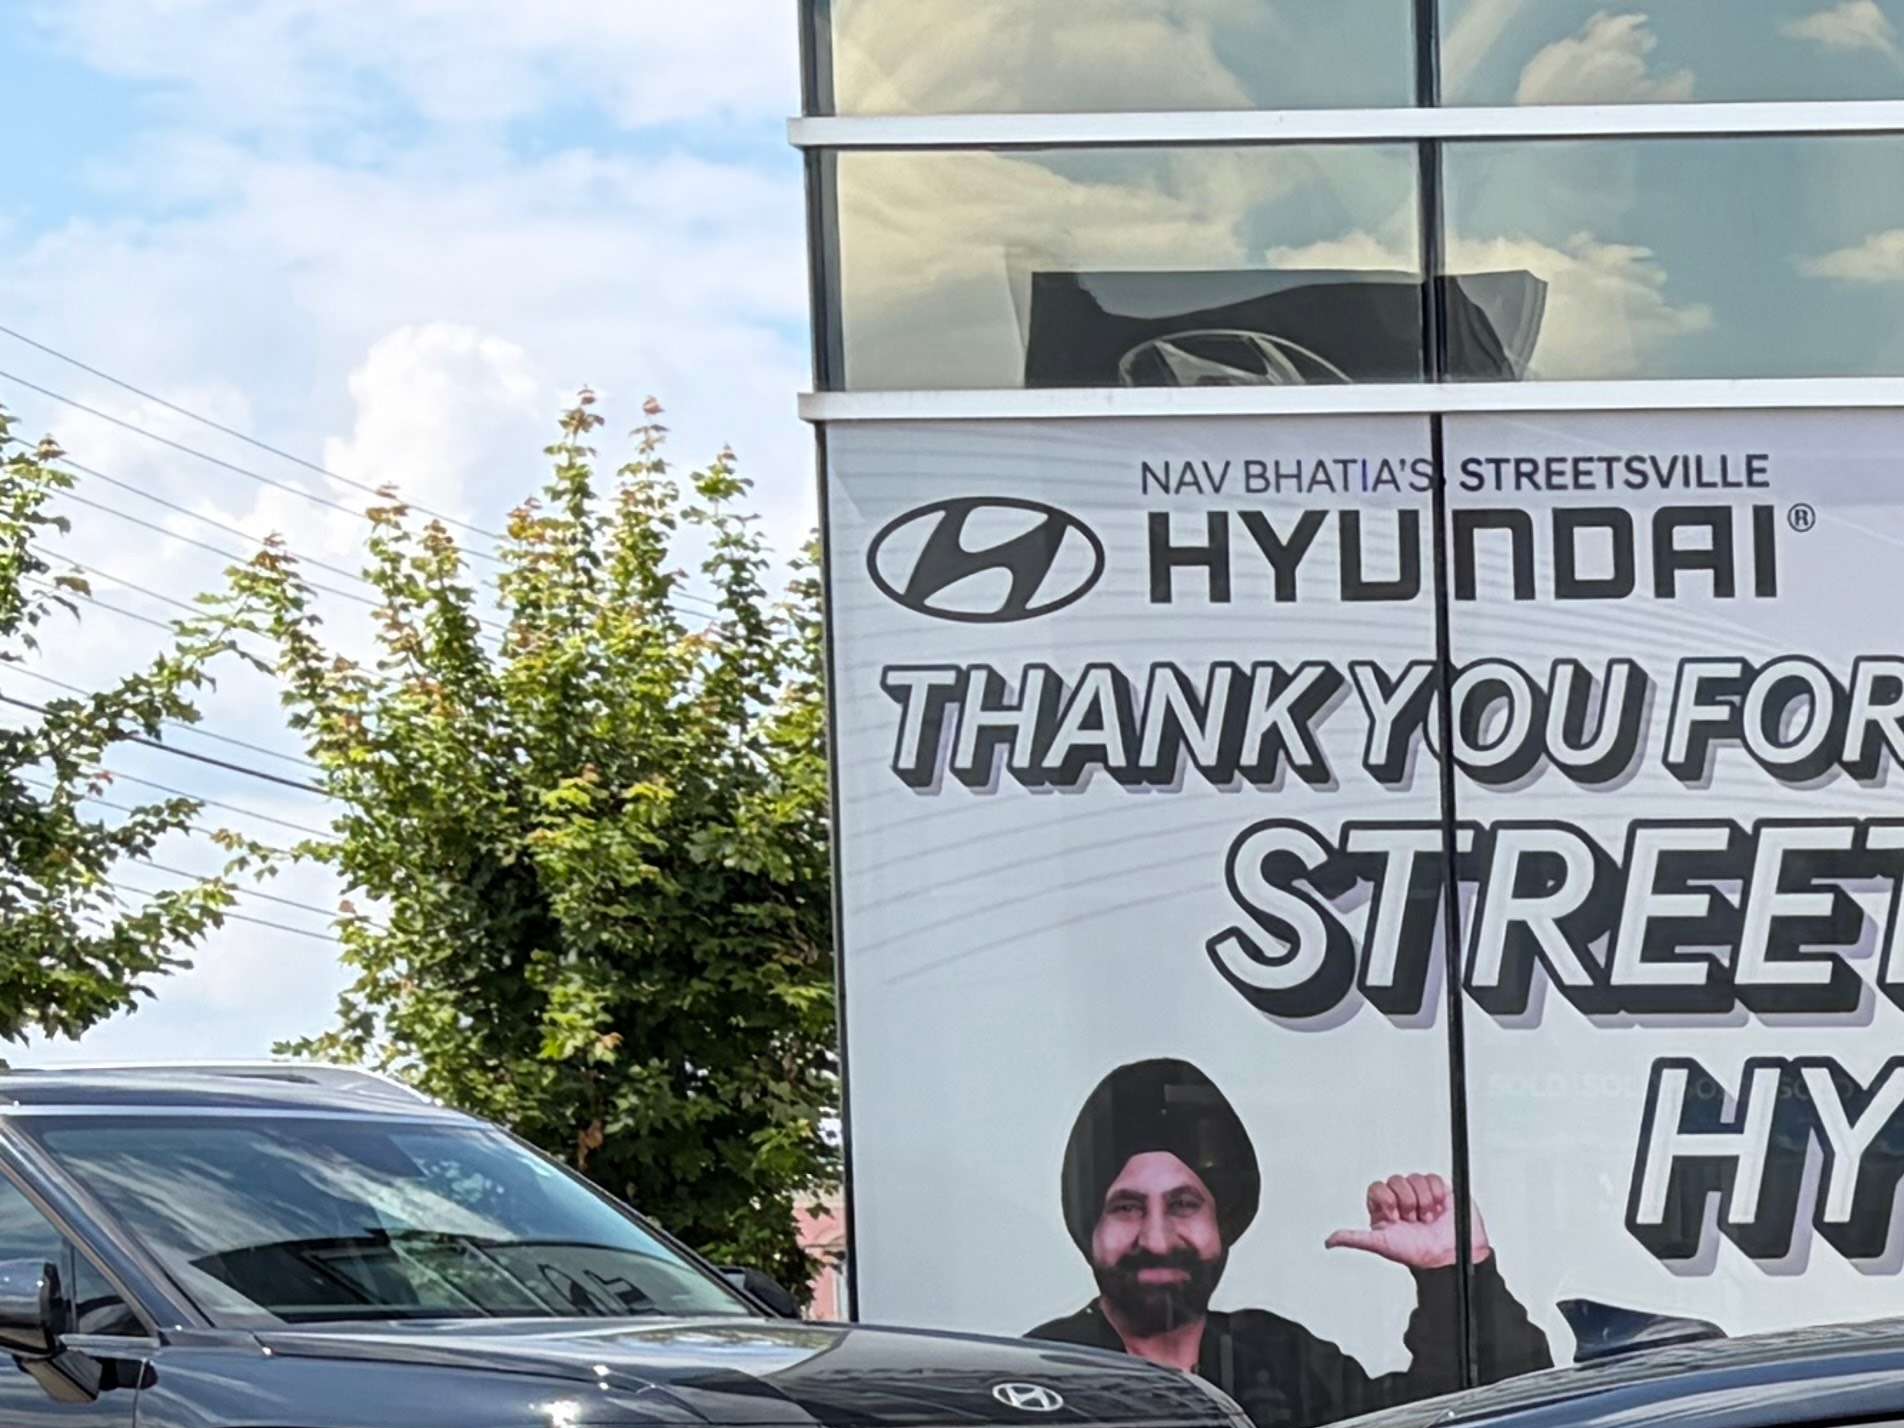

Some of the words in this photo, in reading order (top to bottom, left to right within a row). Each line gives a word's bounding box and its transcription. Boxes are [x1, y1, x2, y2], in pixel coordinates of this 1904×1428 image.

[1141, 459, 1231, 495] NAV
[1244, 457, 1436, 494] BHATIA'S
[1459, 454, 1771, 492] STREETSVILLE
[882, 660, 1346, 790] THANK
[1348, 656, 1654, 790] YOU
